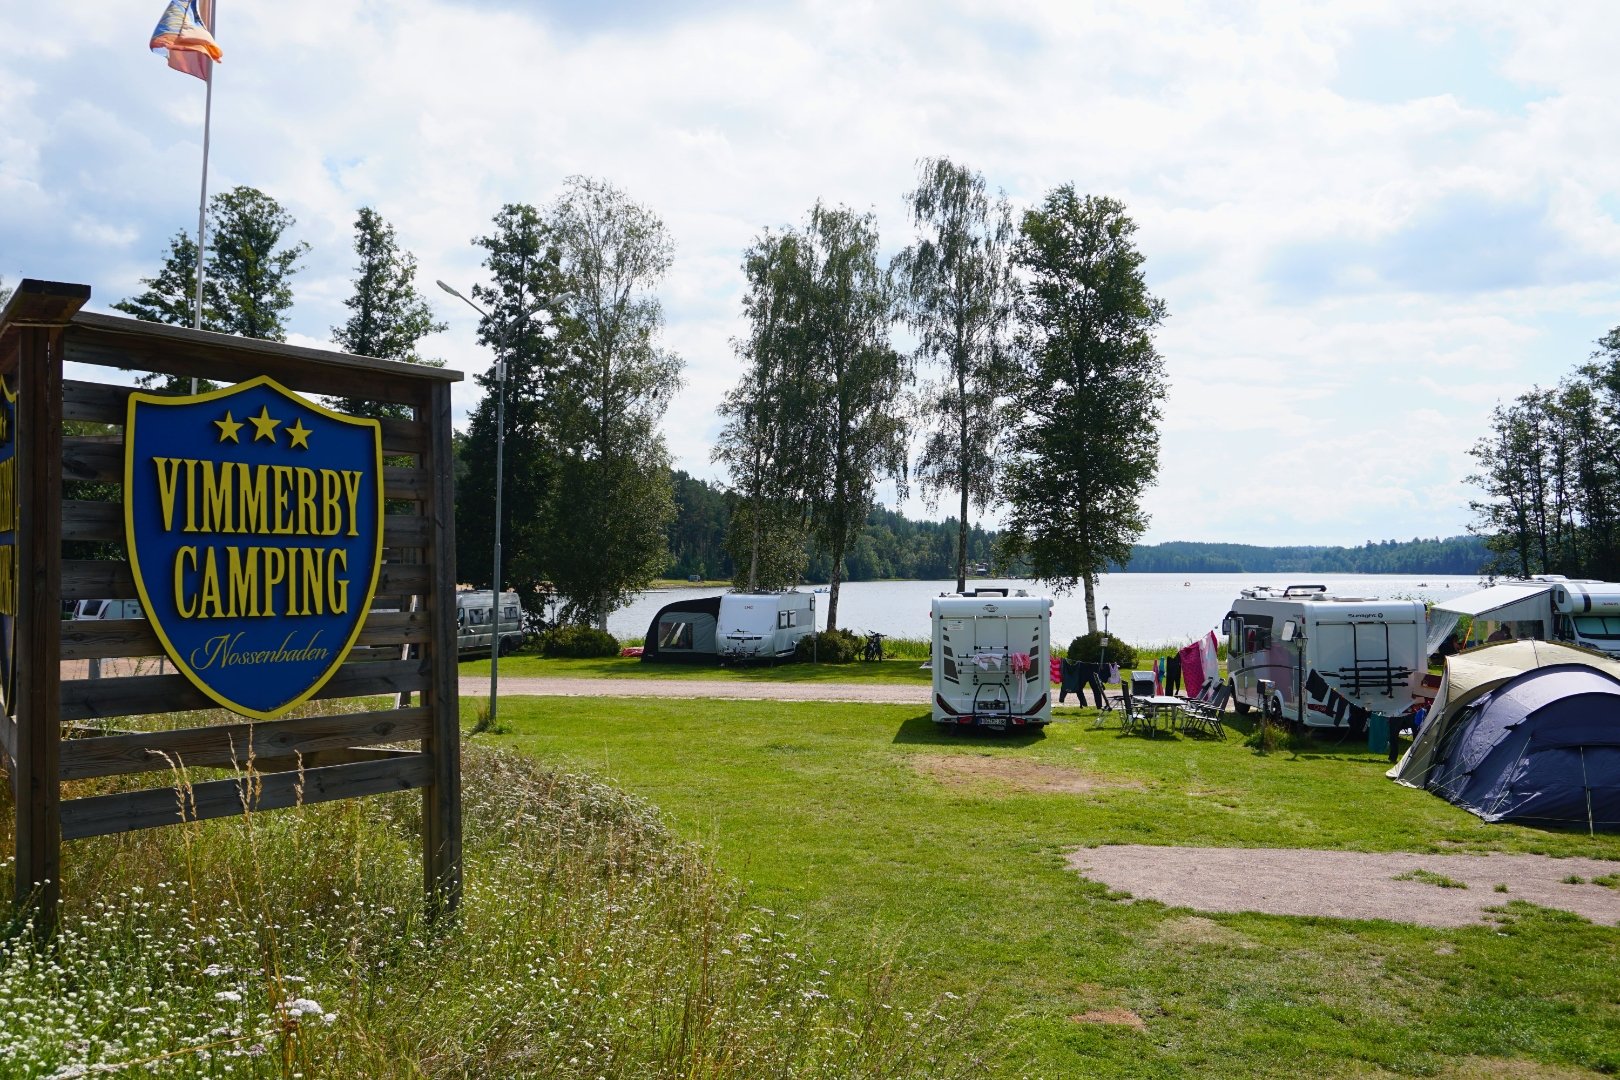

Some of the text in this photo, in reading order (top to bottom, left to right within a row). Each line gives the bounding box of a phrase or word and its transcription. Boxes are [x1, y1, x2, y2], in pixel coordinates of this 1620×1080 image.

[152, 456, 363, 536] VIMMERBY
[174, 545, 350, 618] CAMPING
[190, 629, 329, 670] Nossenbaden
